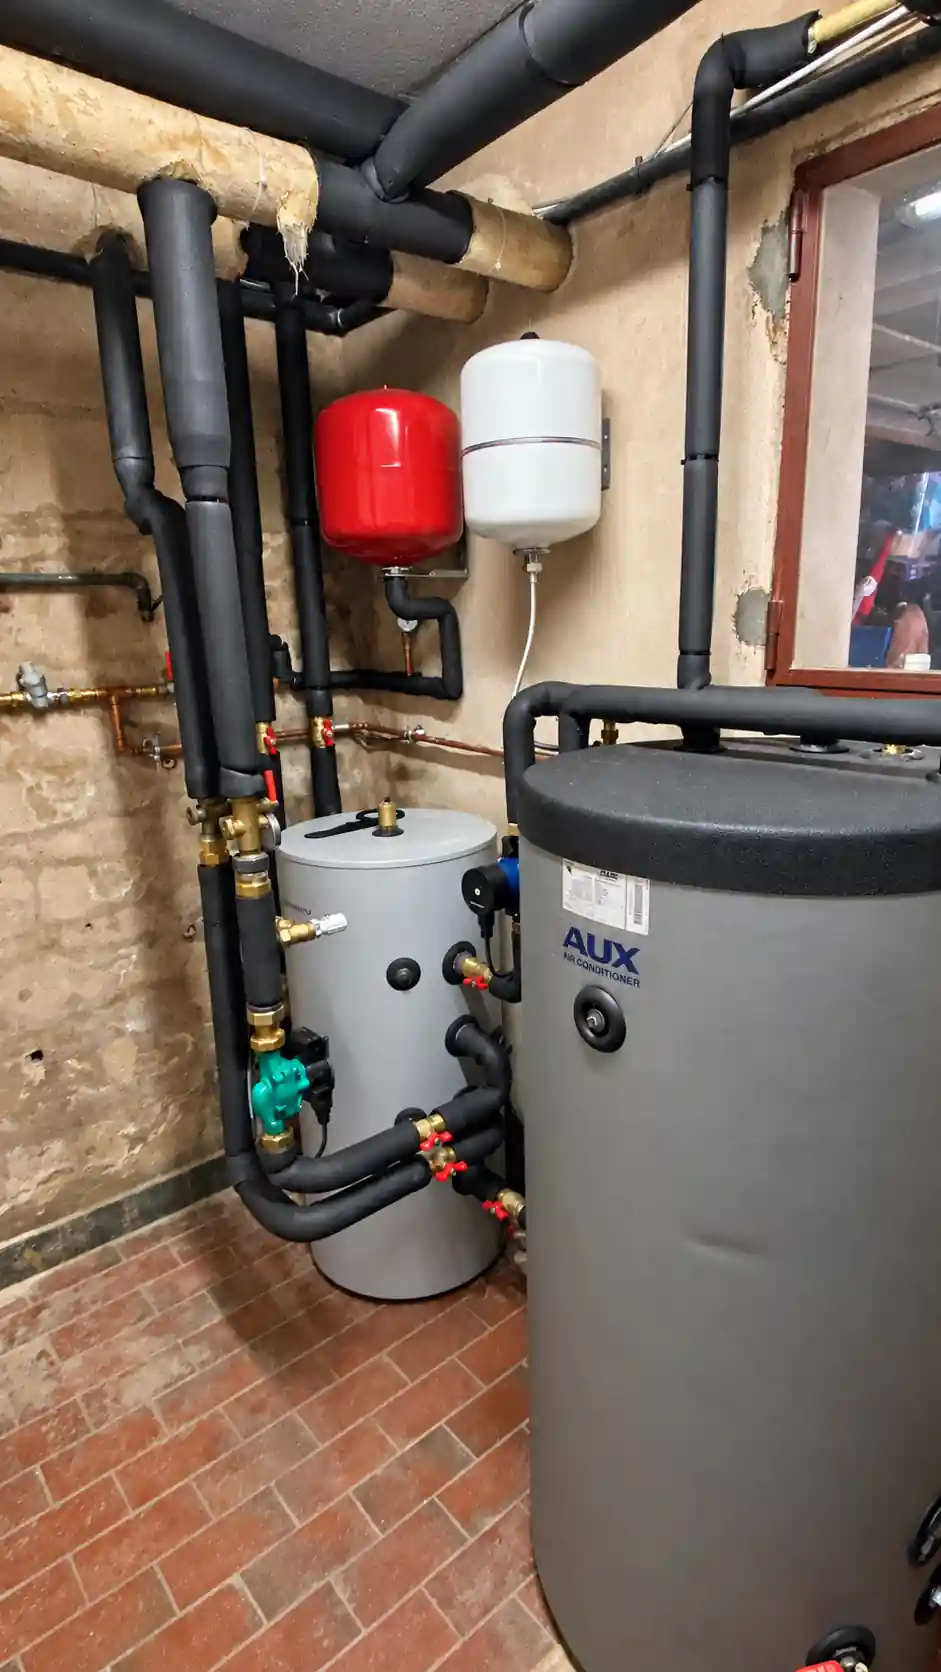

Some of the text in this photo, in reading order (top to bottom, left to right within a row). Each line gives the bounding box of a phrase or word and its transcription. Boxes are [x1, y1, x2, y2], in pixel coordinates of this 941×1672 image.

[563, 926, 640, 975] AUX
[563, 952, 640, 988] AIR CONDITIONER
